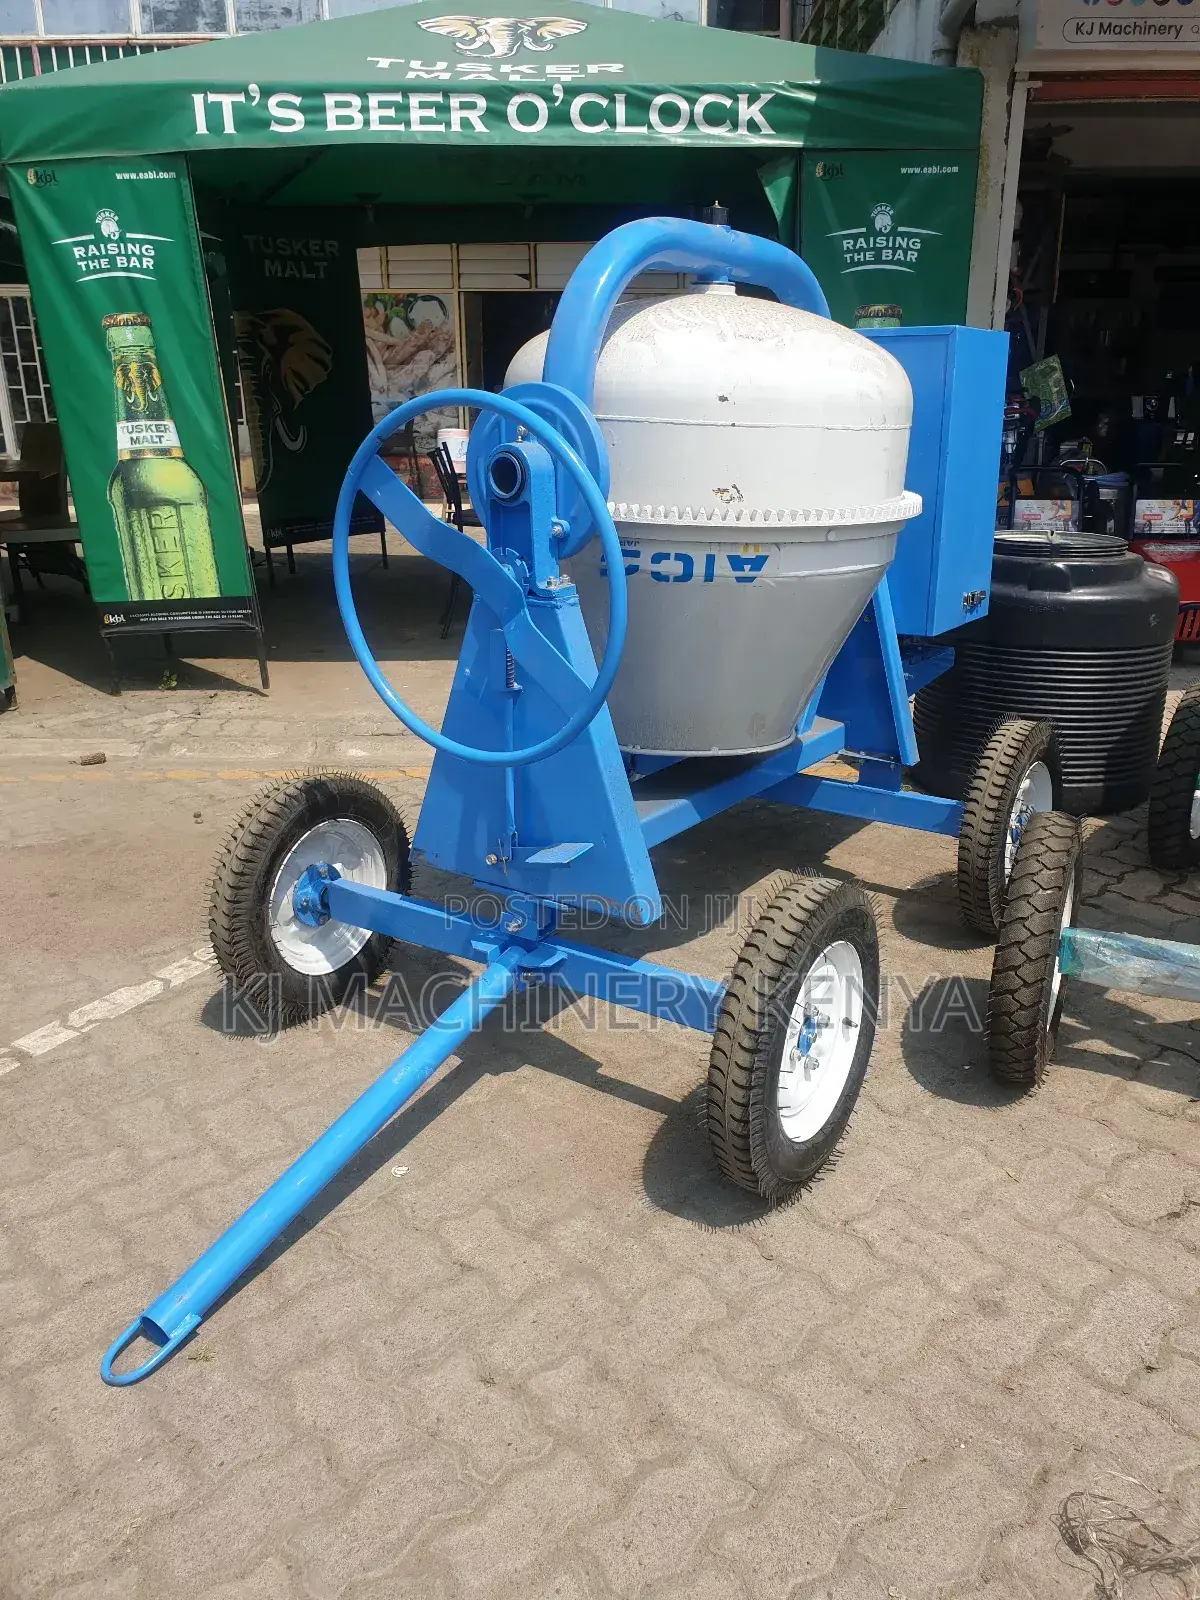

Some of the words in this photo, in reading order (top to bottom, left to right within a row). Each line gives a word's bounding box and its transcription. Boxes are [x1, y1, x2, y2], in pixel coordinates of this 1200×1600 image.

[1075, 21, 1095, 36] KJ
[1098, 20, 1183, 39] Machinery
[366, 56, 625, 73] TUSKER
[405, 71, 585, 82] MALT
[191, 83, 306, 135] IT'S
[323, 91, 490, 133] BEER
[506, 83, 777, 135] O'CLOCK
[115, 171, 177, 180] www.eabl.com
[900, 165, 959, 174] www.eabl.com
[95, 210, 120, 224] TUSKER
[870, 205, 895, 218] TUSKER
[242, 234, 340, 257] TUSKER
[843, 236, 921, 251] RAISING
[72, 243, 155, 259] RAISING
[844, 251, 875, 263] THE
[881, 250, 918, 263] BAR
[77, 258, 110, 271] THE
[116, 256, 156, 270] BAR
[264, 259, 328, 279] MALT
[120, 423, 172, 434] TUSKER
[130, 435, 165, 446] MALT
